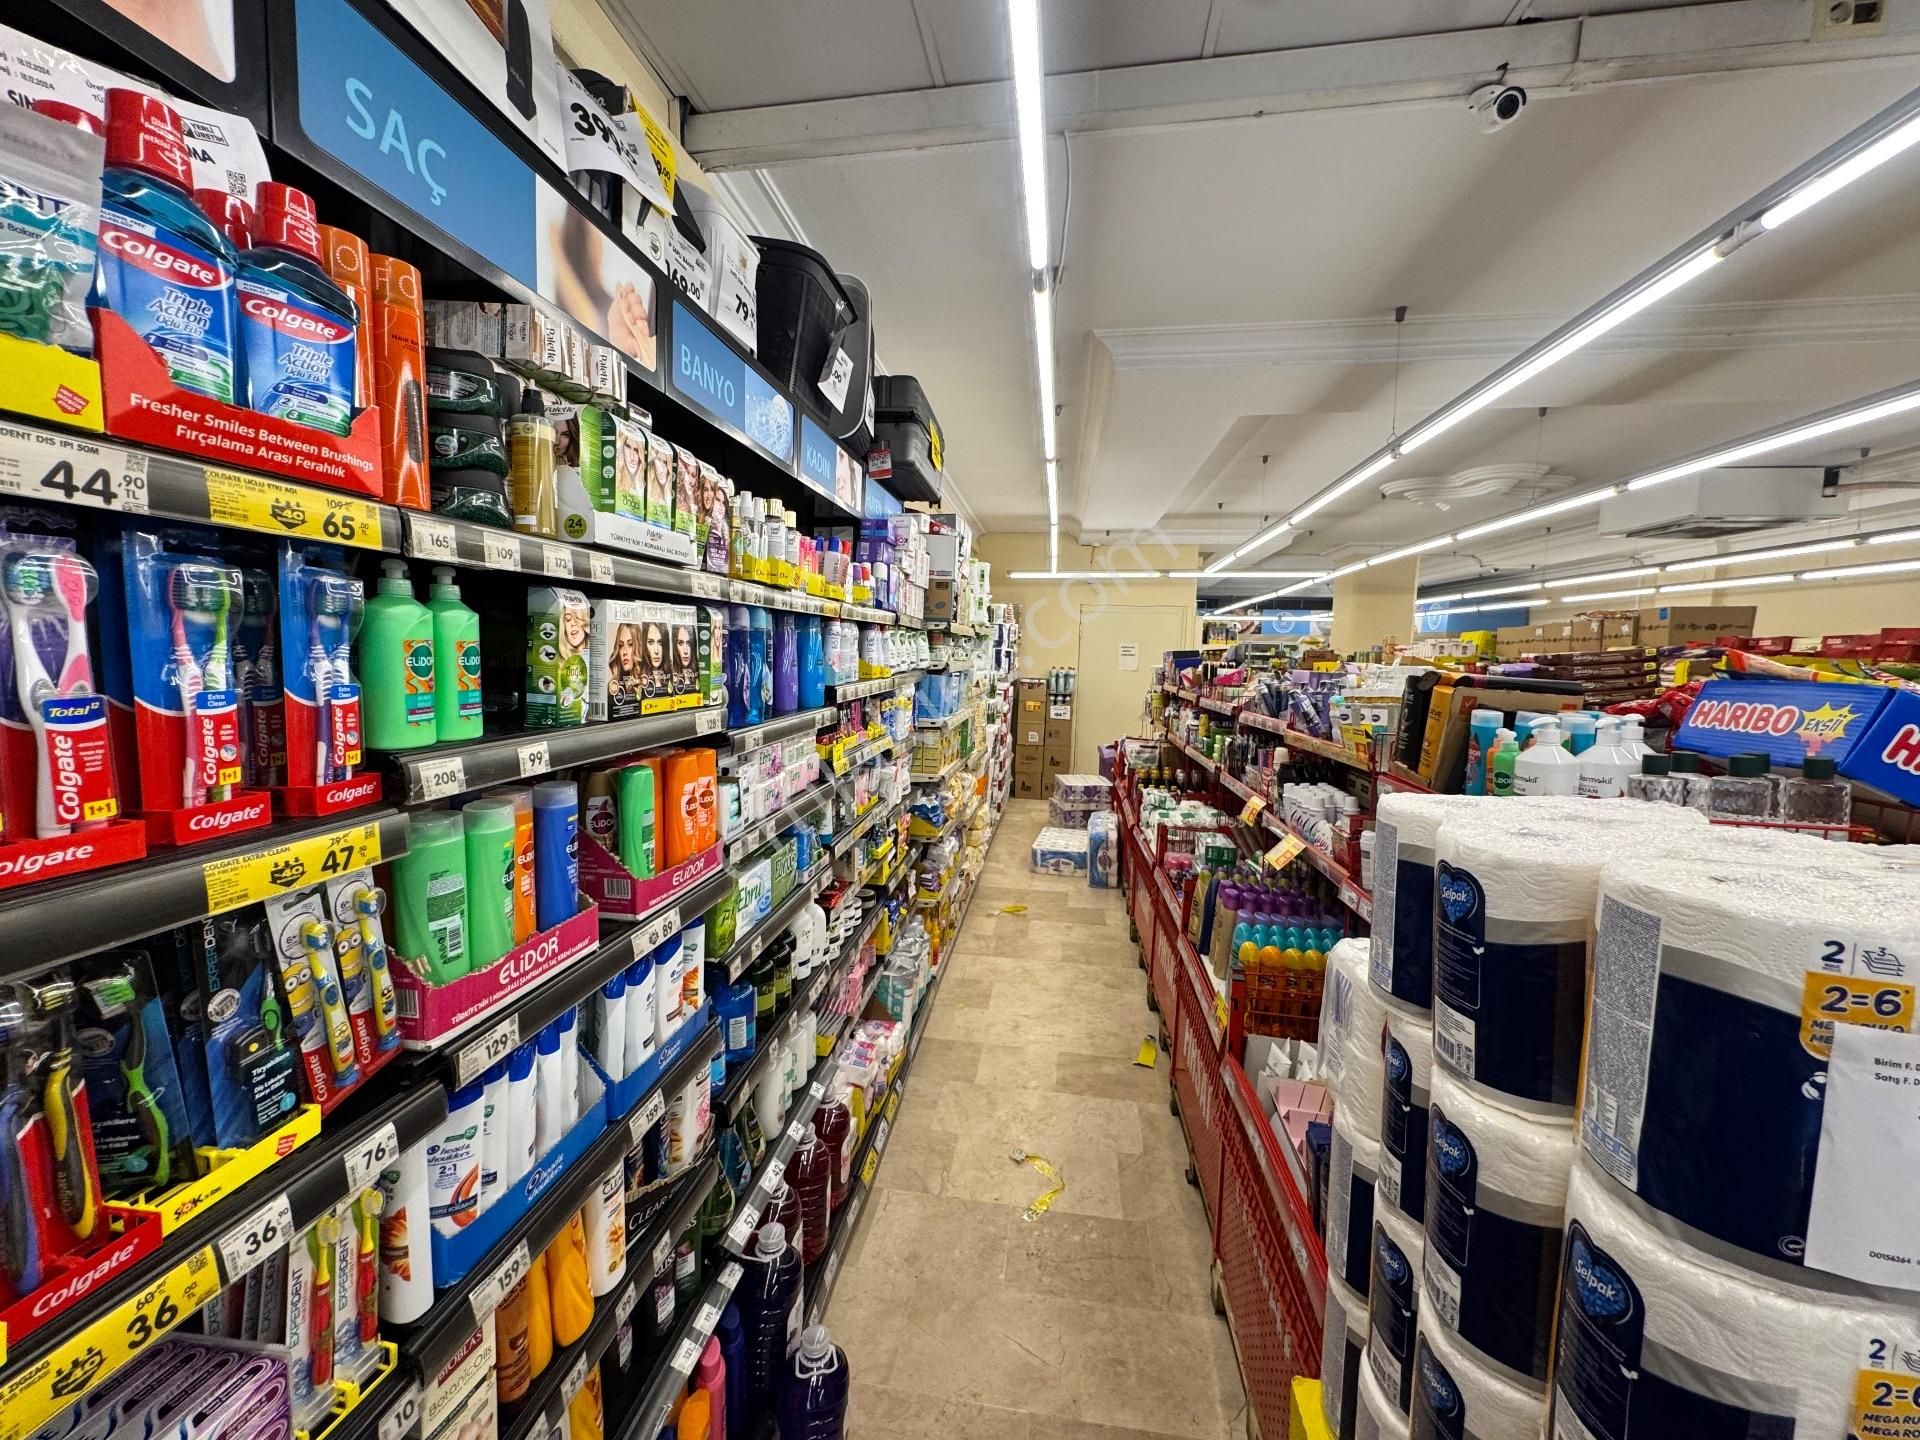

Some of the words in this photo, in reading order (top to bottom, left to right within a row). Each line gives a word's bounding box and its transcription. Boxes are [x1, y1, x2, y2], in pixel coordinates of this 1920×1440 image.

[344, 76, 447, 207] SAÇ
[186, 146, 216, 165] MA
[102, 229, 214, 284] Colgate
[150, 300, 209, 328] Action
[164, 288, 212, 316] Triple
[245, 299, 337, 340] Colgate
[294, 344, 333, 367] Triple
[546, 327, 556, 363] Palette
[280, 354, 329, 376] Action
[681, 343, 736, 410] BANYO
[36, 435, 56, 446] DIS
[130, 393, 200, 421] Fresher
[204, 414, 255, 439] Smiles
[258, 428, 318, 455] Between
[321, 445, 374, 472] Brushings
[176, 426, 254, 458] Fırçalama
[257, 445, 293, 466] Arası
[295, 455, 346, 478] Ferahlık
[806, 444, 831, 480] KADIN
[40, 460, 118, 506] 44
[124, 489, 140, 501] TL
[322, 512, 356, 541] 65
[567, 518, 583, 528] 24
[429, 534, 449, 548] 165
[496, 547, 514, 560] 109
[555, 557, 568, 570] 173
[406, 656, 433, 667] ELiDO
[458, 656, 480, 666] ELiDO
[208, 693, 226, 701] Extra
[208, 700, 227, 708] Clean
[1690, 701, 1797, 735] HARIBO
[335, 708, 343, 765] Colgate
[203, 716, 217, 786] Colgate
[347, 753, 358, 763] 1+1
[528, 751, 545, 767] 99
[54, 735, 81, 820] Colgate
[221, 770, 239, 781] 1+1
[434, 771, 457, 787] 208
[326, 782, 376, 804] Colgate
[88, 803, 113, 815] 1+1
[190, 803, 263, 831] Colgate
[589, 820, 615, 829] ELiDO
[0, 845, 94, 876] olgate
[243, 853, 265, 863] EXTRA
[267, 846, 290, 857] CLEAN
[321, 845, 354, 874] 47
[518, 852, 534, 865] ELiDO
[672, 858, 706, 886] ELiDOR
[738, 881, 762, 912] Ebru
[1442, 886, 1468, 902] Selpak
[662, 920, 673, 938] 89
[203, 917, 219, 993] EXPERDEN
[499, 936, 559, 985] ELiDOR
[1821, 940, 1846, 963] 2
[1877, 947, 1887, 957] 3
[1810, 1020, 1835, 1031] ME
[353, 1019, 371, 1065] Colgate
[484, 1034, 508, 1060] 129
[1809, 1034, 1834, 1045] ME
[1874, 1057, 1902, 1069] Birim
[1905, 1062, 1913, 1071] F.
[310, 1055, 328, 1102] Colgate
[1874, 1072, 1900, 1086] Satış
[1902, 1077, 1911, 1085] F.
[644, 1105, 659, 1126] 159
[362, 1146, 387, 1170] 76
[1434, 1132, 1460, 1159] Selpak
[629, 1194, 667, 1231] CLEAR
[744, 1214, 757, 1230] 57
[244, 1218, 278, 1256] 36
[1379, 1244, 1401, 1271] Selpak
[32, 1241, 135, 1318] Colgate
[338, 1236, 350, 1312] EXPERDENT
[499, 1260, 521, 1292] 159
[1574, 1258, 1616, 1301] Selpak
[290, 1266, 303, 1349] EXPERDENT
[126, 1296, 178, 1350] 36
[1869, 1338, 1886, 1361] 2
[569, 1368, 584, 1394] 54
[1421, 1362, 1449, 1398] Selpak
[393, 1399, 416, 1429] 10
[1862, 1413, 1900, 1425] MEGA
[1902, 1415, 1920, 1426] RU
[1862, 1425, 1901, 1438] MEGA
